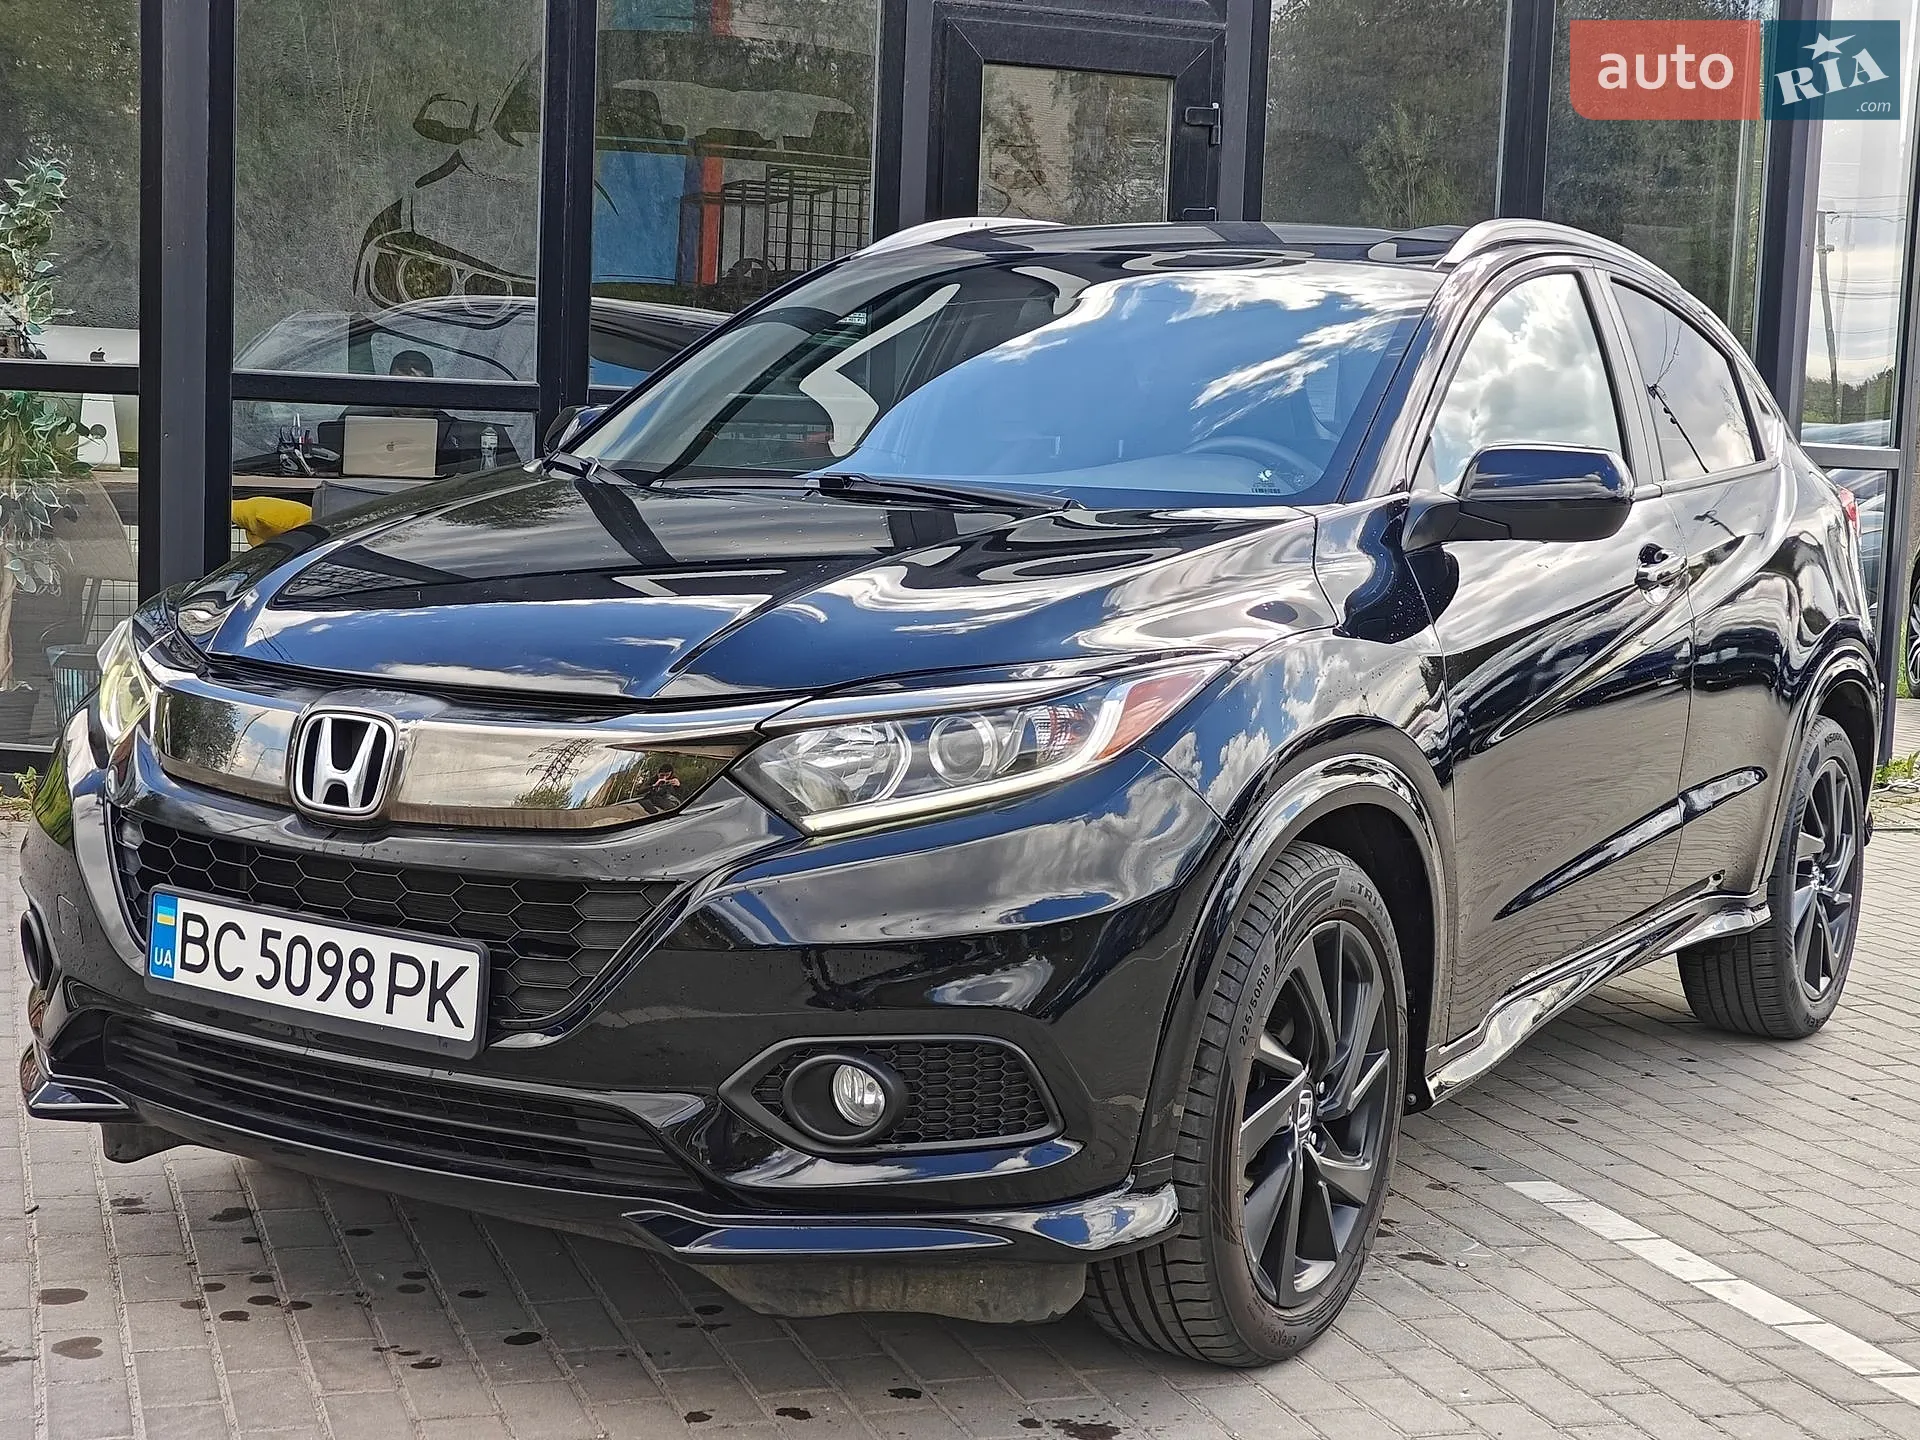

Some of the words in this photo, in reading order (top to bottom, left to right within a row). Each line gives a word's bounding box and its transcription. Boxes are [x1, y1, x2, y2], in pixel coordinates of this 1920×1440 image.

[154, 946, 173, 967] UA
[179, 911, 246, 982] BC
[256, 927, 376, 1009] 5098
[385, 952, 470, 1029] PK
[1239, 963, 1272, 1047] 225/50R18
